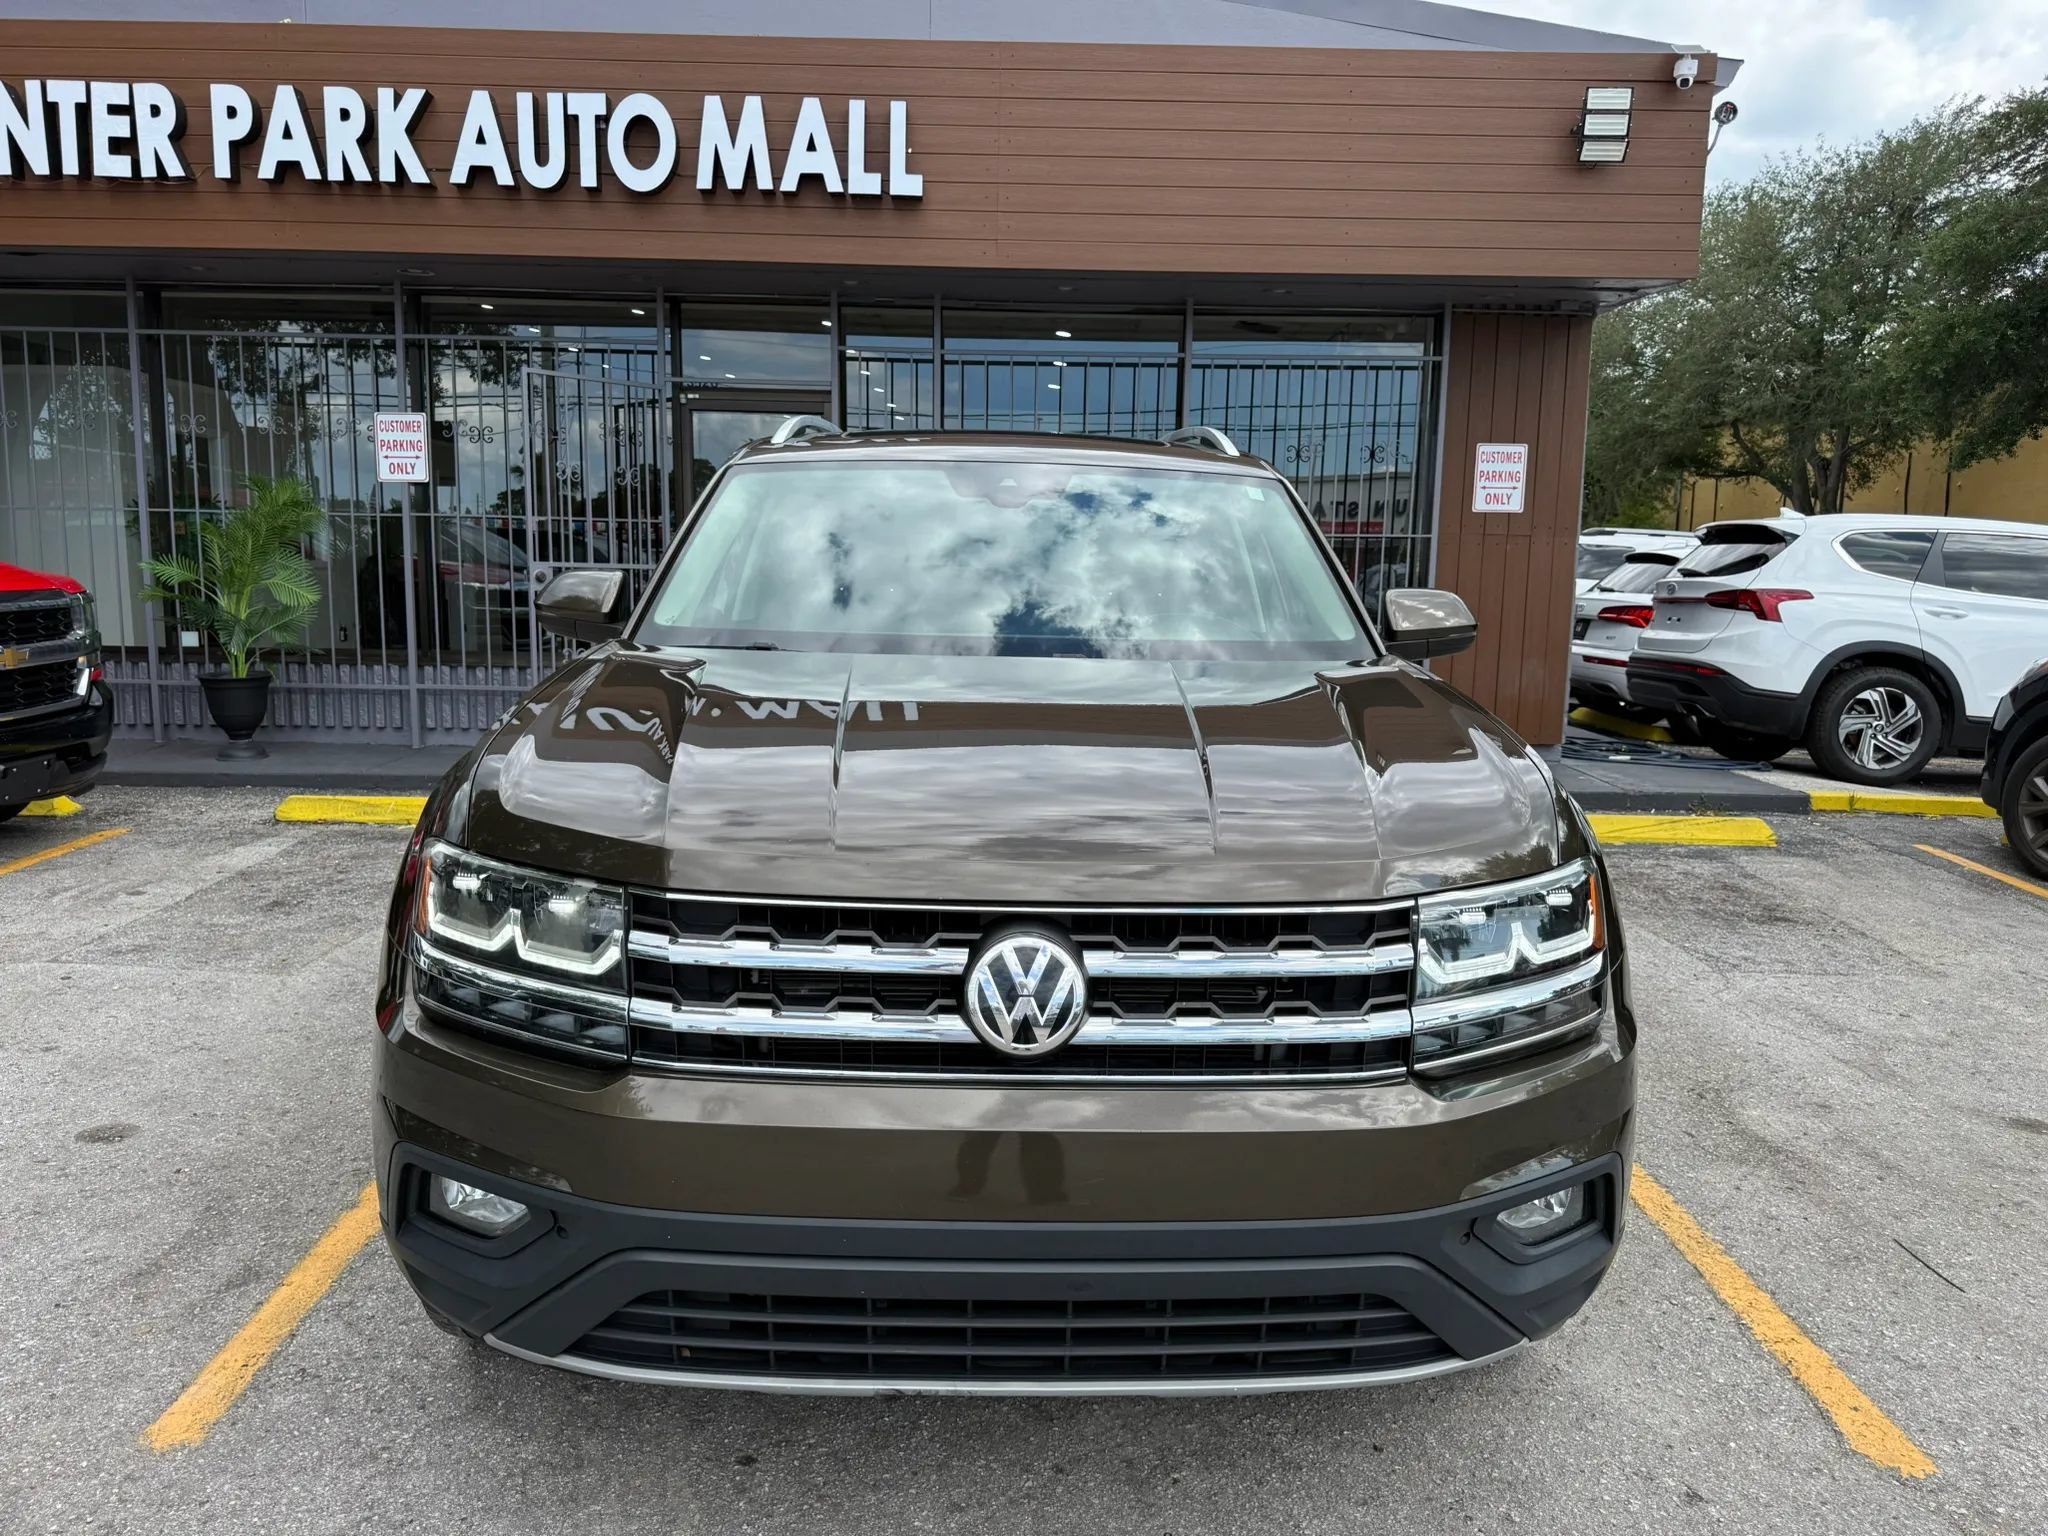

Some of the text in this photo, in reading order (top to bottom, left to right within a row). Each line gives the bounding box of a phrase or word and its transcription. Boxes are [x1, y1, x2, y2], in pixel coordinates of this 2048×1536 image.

[209, 83, 432, 184] PARK
[449, 90, 677, 192] AUTO
[696, 95, 924, 197] MALL
[379, 420, 422, 433] CUSTOMER
[380, 439, 423, 452] PARKING
[1480, 451, 1522, 464] CUSTOMER
[388, 462, 416, 475] ONLY
[1479, 470, 1521, 483] PARKING
[1484, 492, 1513, 506] ONLY
